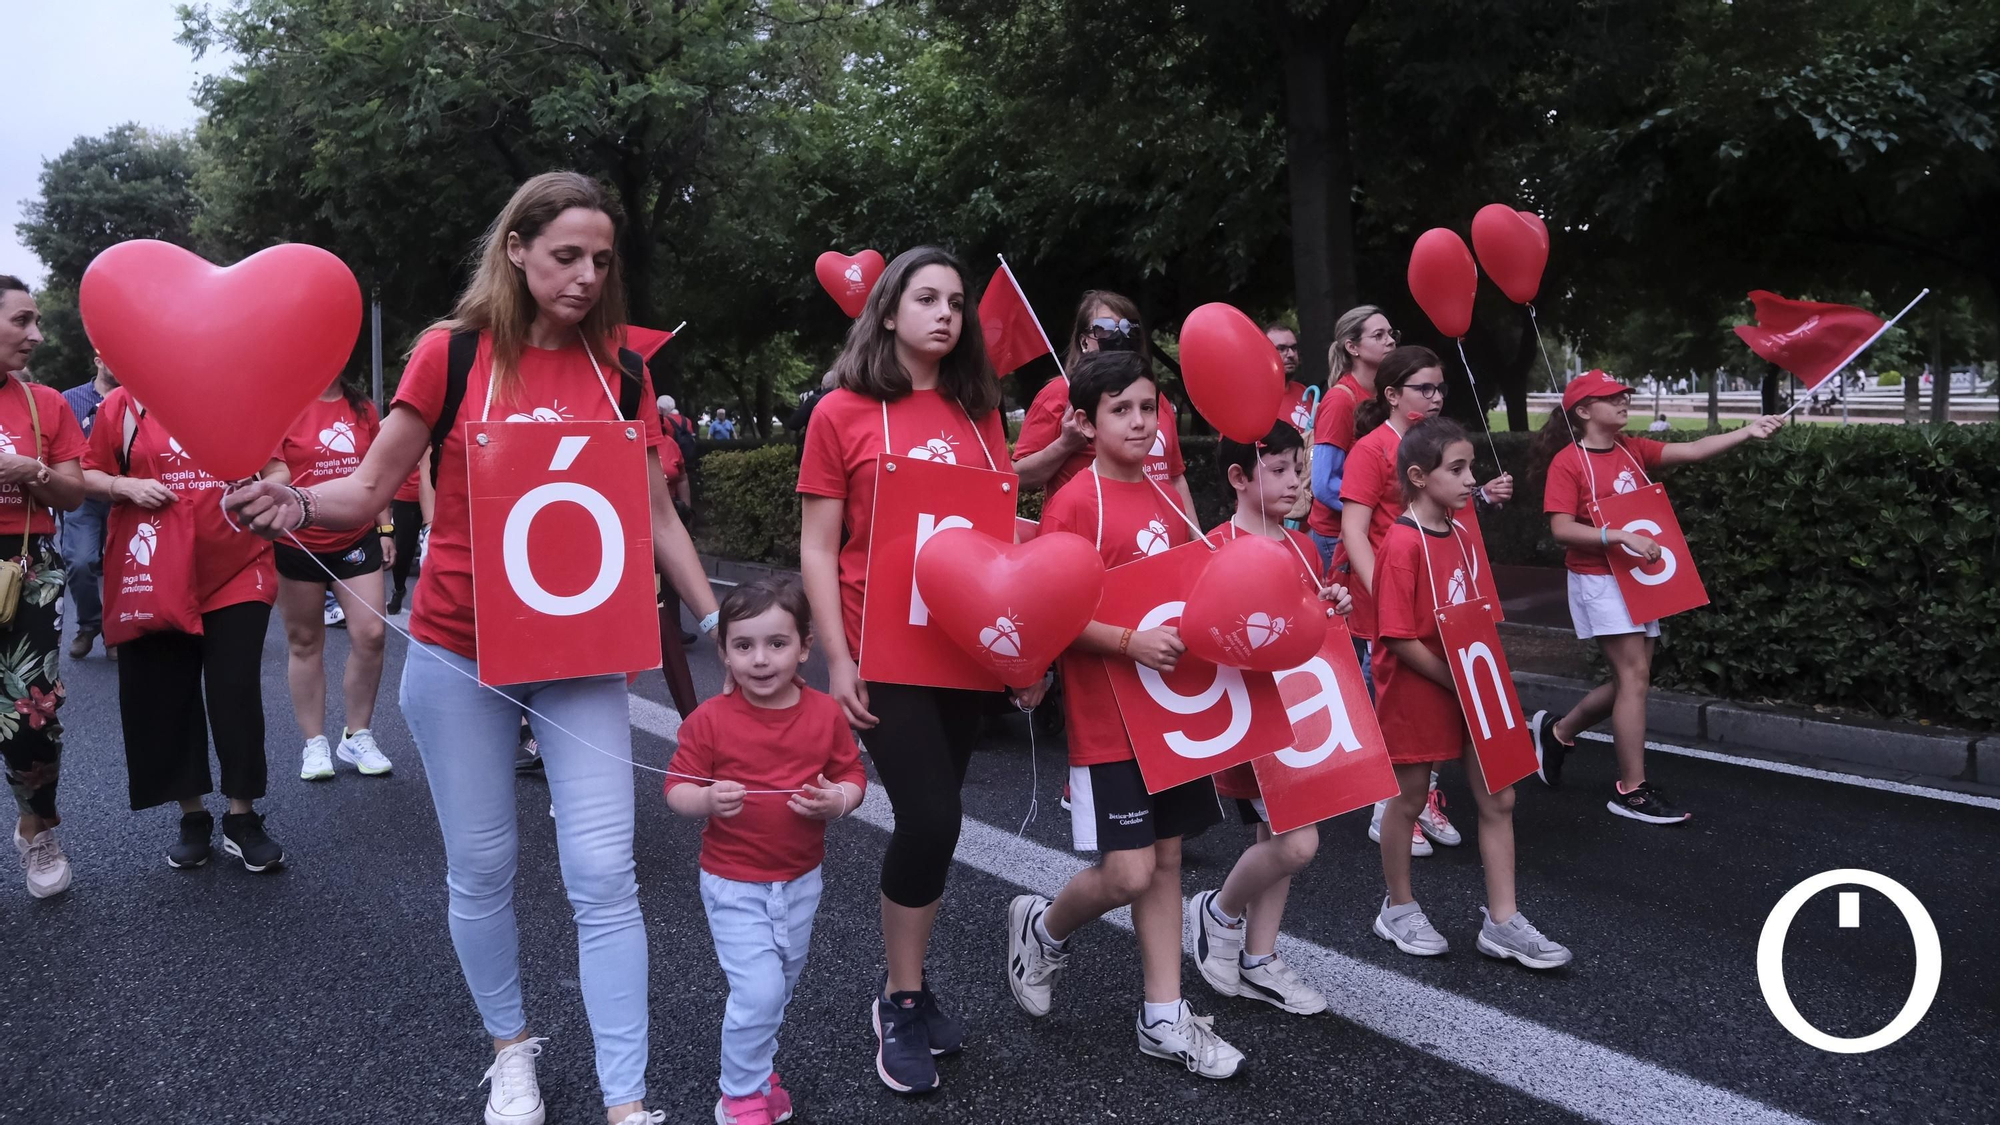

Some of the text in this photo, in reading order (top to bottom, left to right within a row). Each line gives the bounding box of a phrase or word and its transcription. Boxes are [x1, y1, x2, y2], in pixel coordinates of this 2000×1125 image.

[315, 459, 340, 469] regala
[161, 470, 195, 482] regala
[313, 465, 357, 476] dona órgan
[2, 483, 20, 493] DA
[188, 480, 225, 491] órgano
[0, 496, 22, 504] anos
[1620, 519, 1677, 586] s
[1136, 601, 1252, 759] g
[1457, 641, 1516, 741] n
[1272, 656, 1363, 769] a
